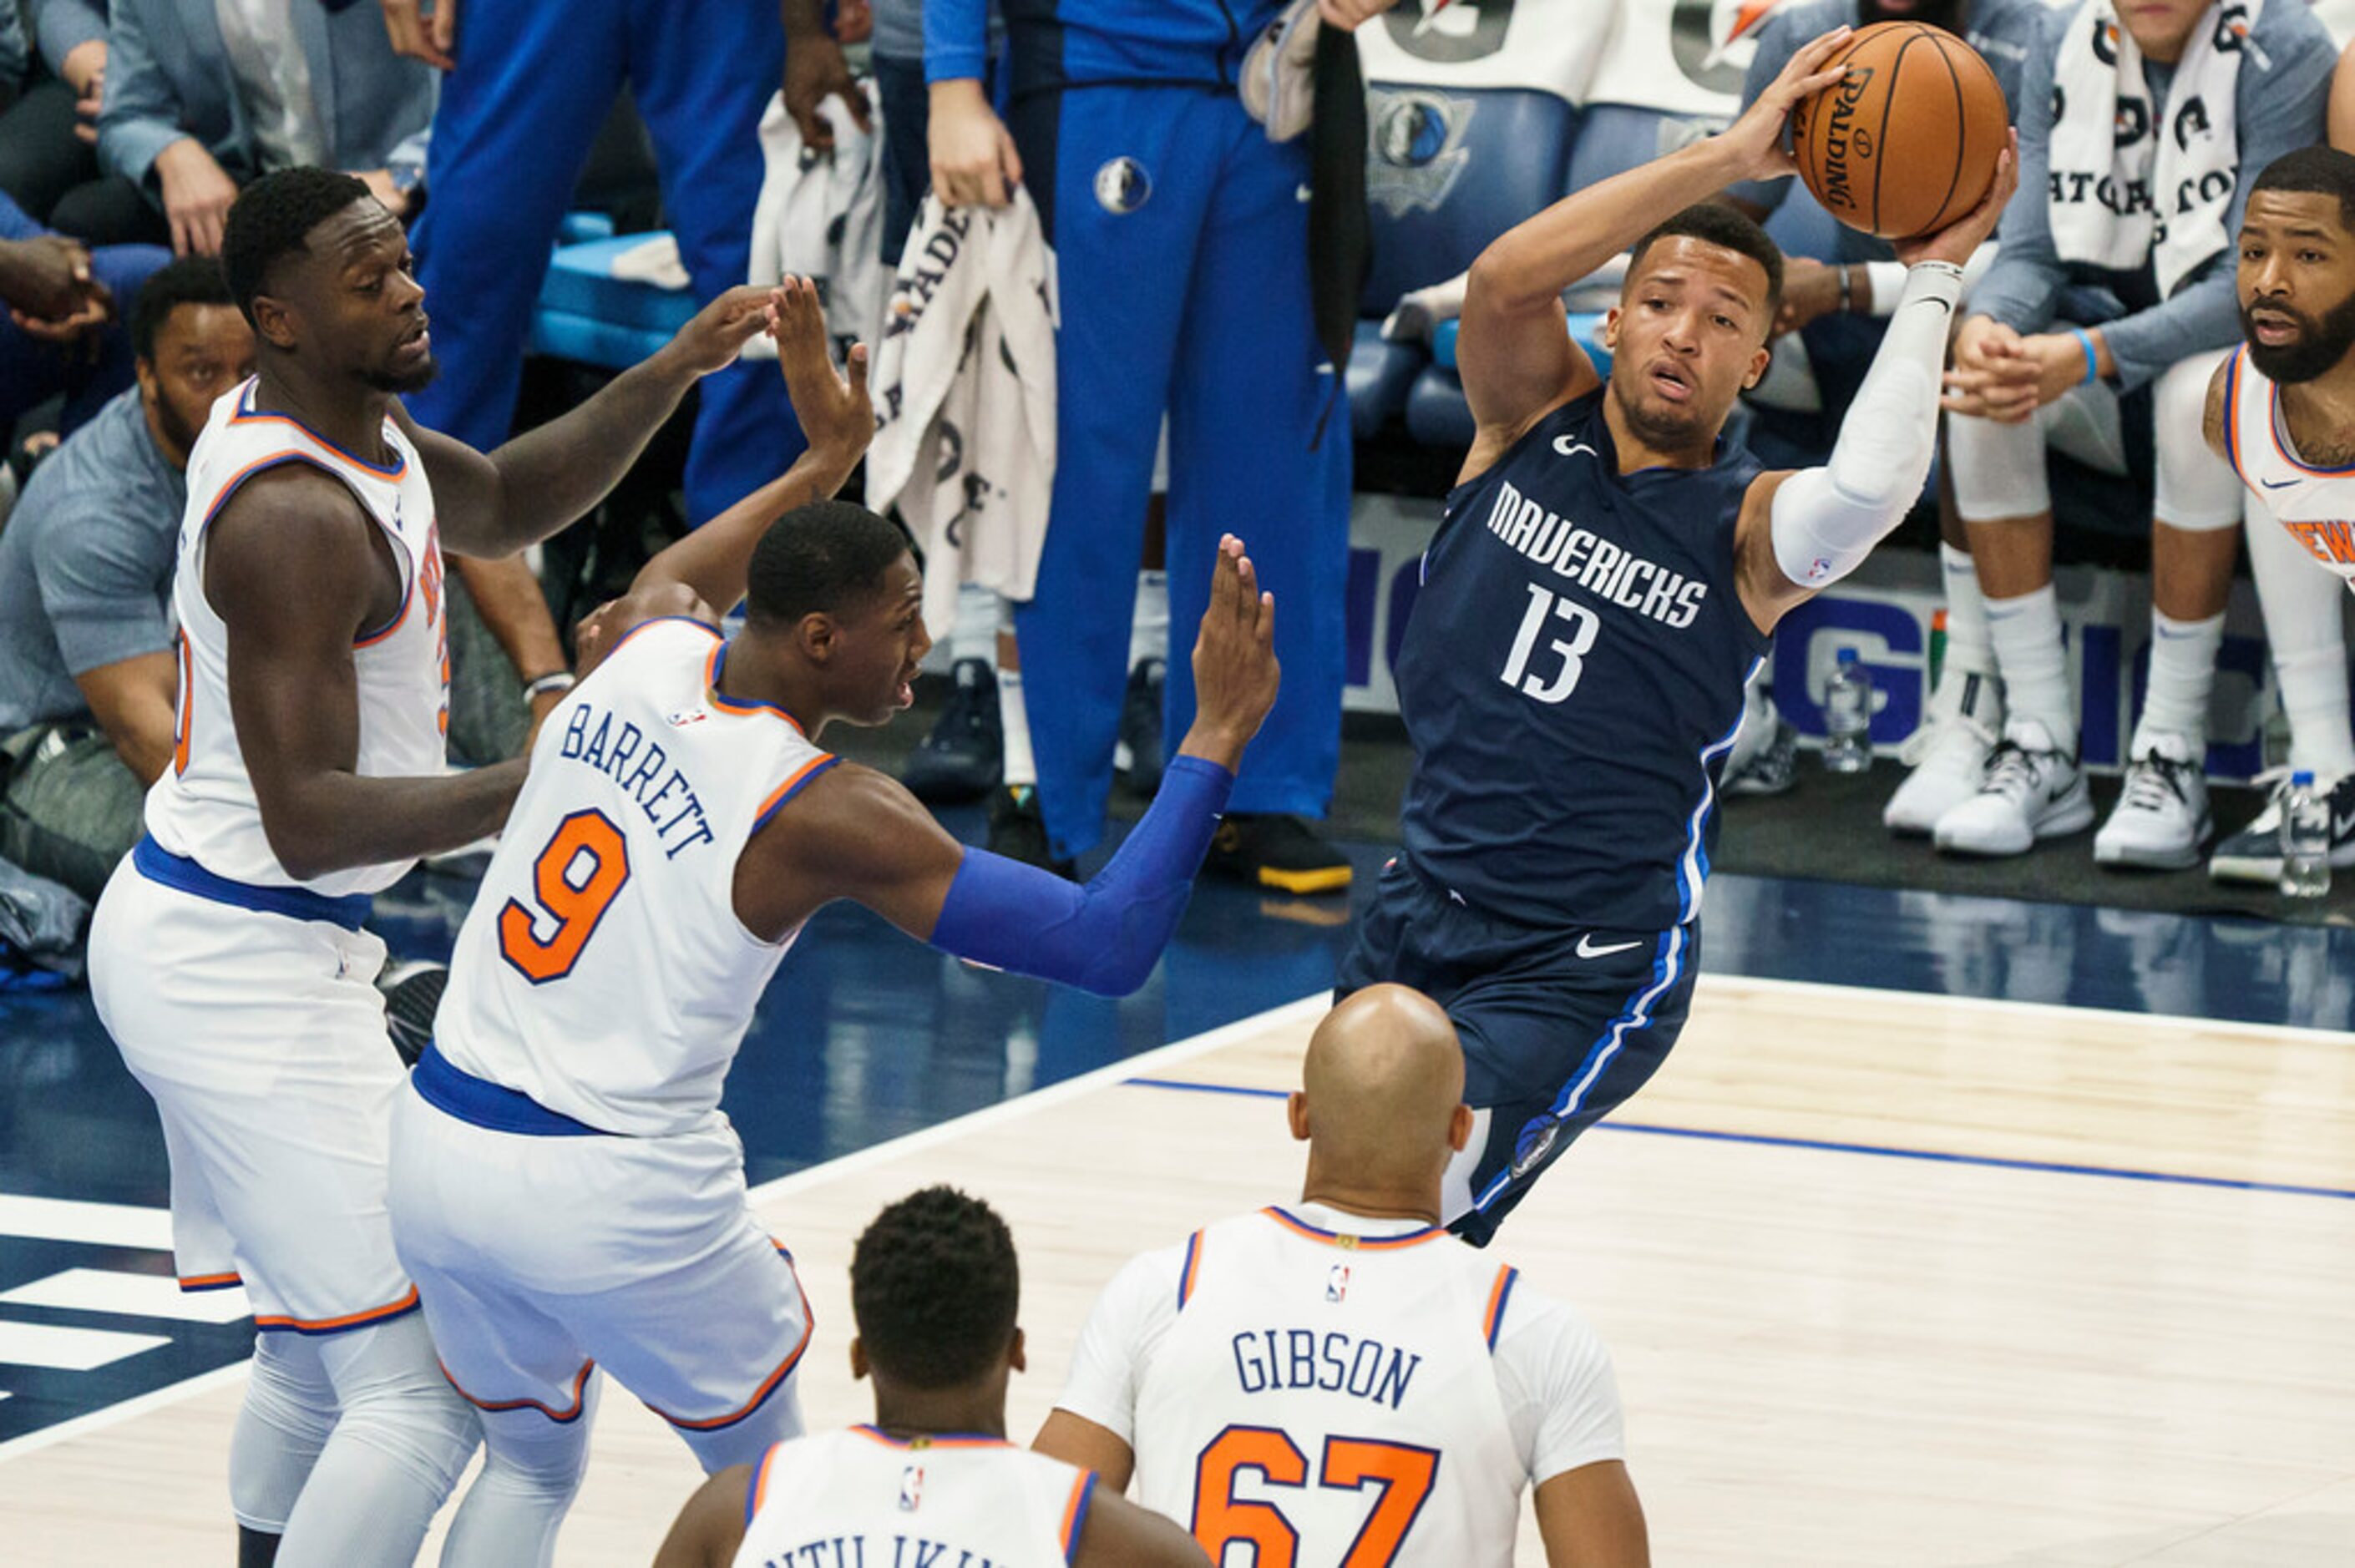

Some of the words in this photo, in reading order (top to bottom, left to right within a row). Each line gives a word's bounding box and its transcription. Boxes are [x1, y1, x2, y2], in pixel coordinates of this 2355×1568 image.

[1486, 479, 1709, 629] MAVERICKS
[1500, 582, 1601, 703] 13
[560, 703, 714, 860] BARRETT
[496, 807, 631, 986] 9
[1232, 1330, 1422, 1410] GIBSON
[1190, 1424, 1442, 1568] 67
